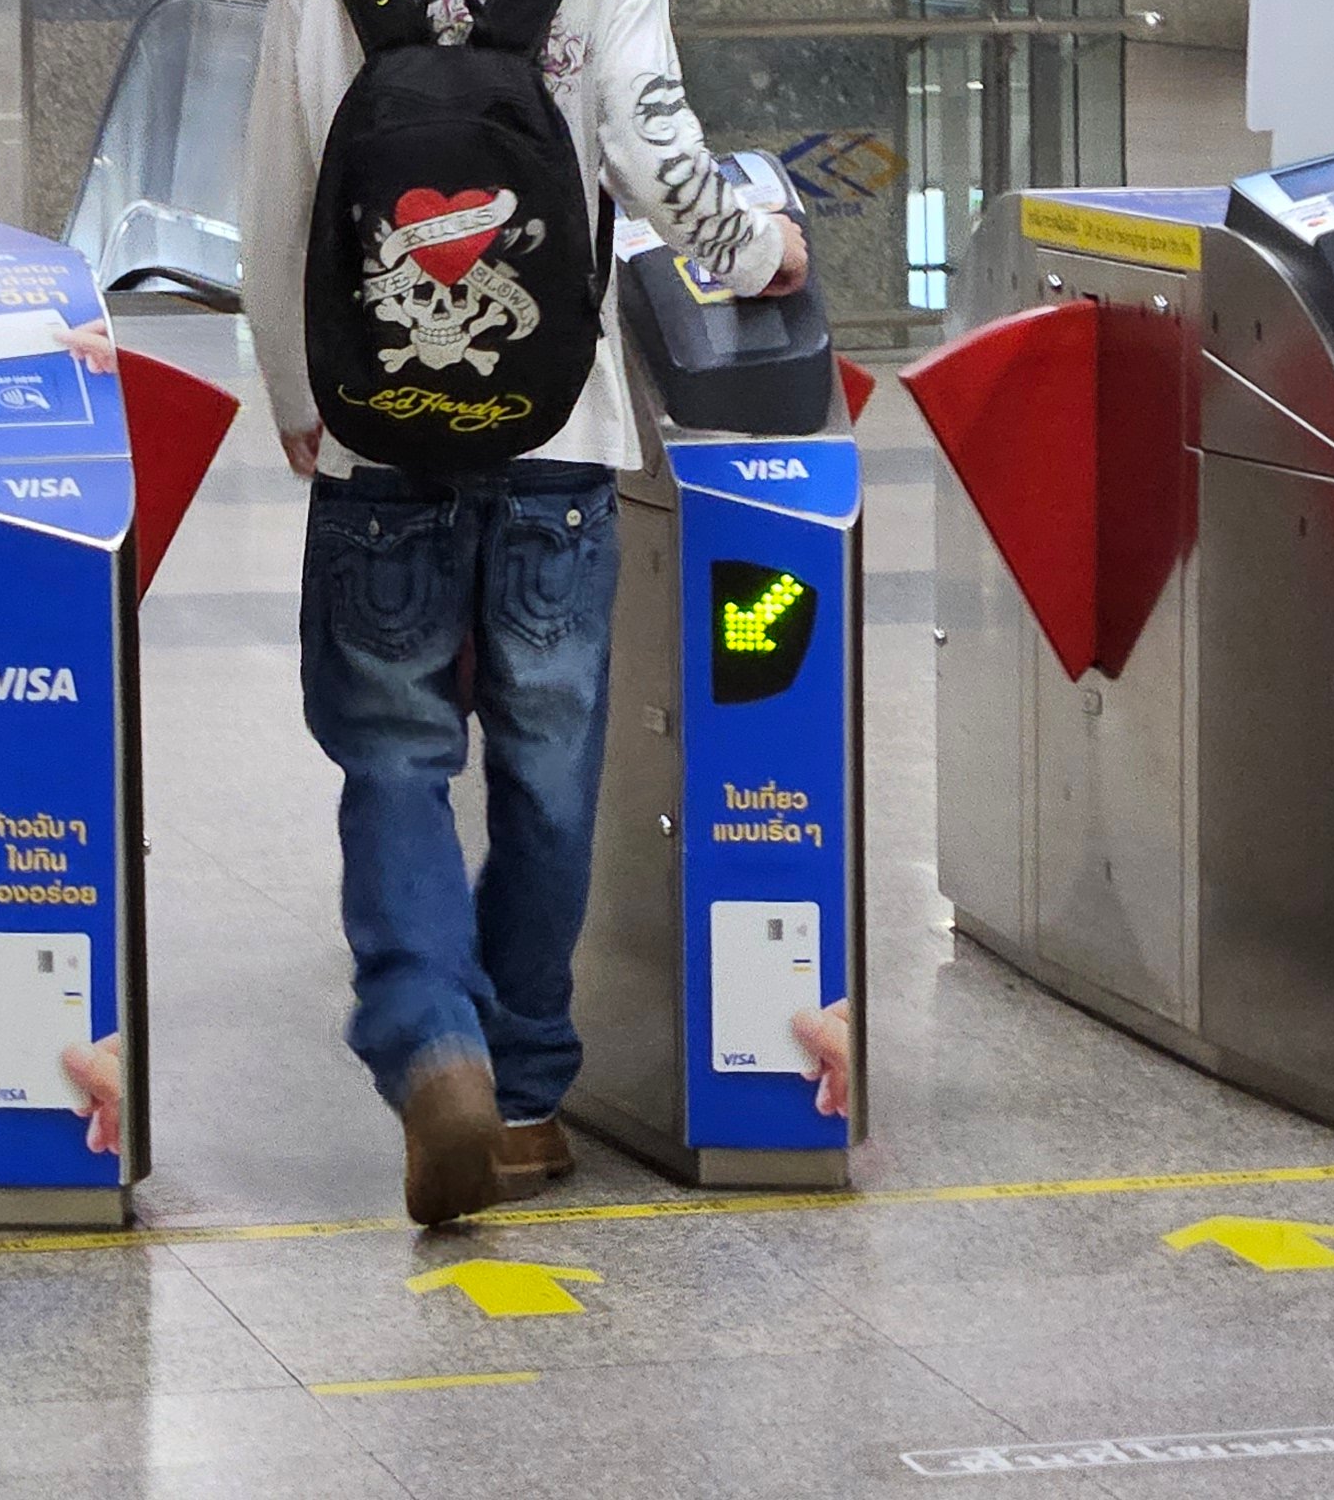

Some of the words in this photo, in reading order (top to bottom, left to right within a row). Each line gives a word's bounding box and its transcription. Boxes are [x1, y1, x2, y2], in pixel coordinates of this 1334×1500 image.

[368, 386, 416, 413] Ed
[411, 387, 533, 432] Hardy
[729, 458, 810, 482] VISA
[2, 476, 82, 499] VISA
[723, 778, 809, 810] ไปเที่ยว
[5, 843, 68, 873] ไปกิน
[720, 1052, 757, 1067] VISA
